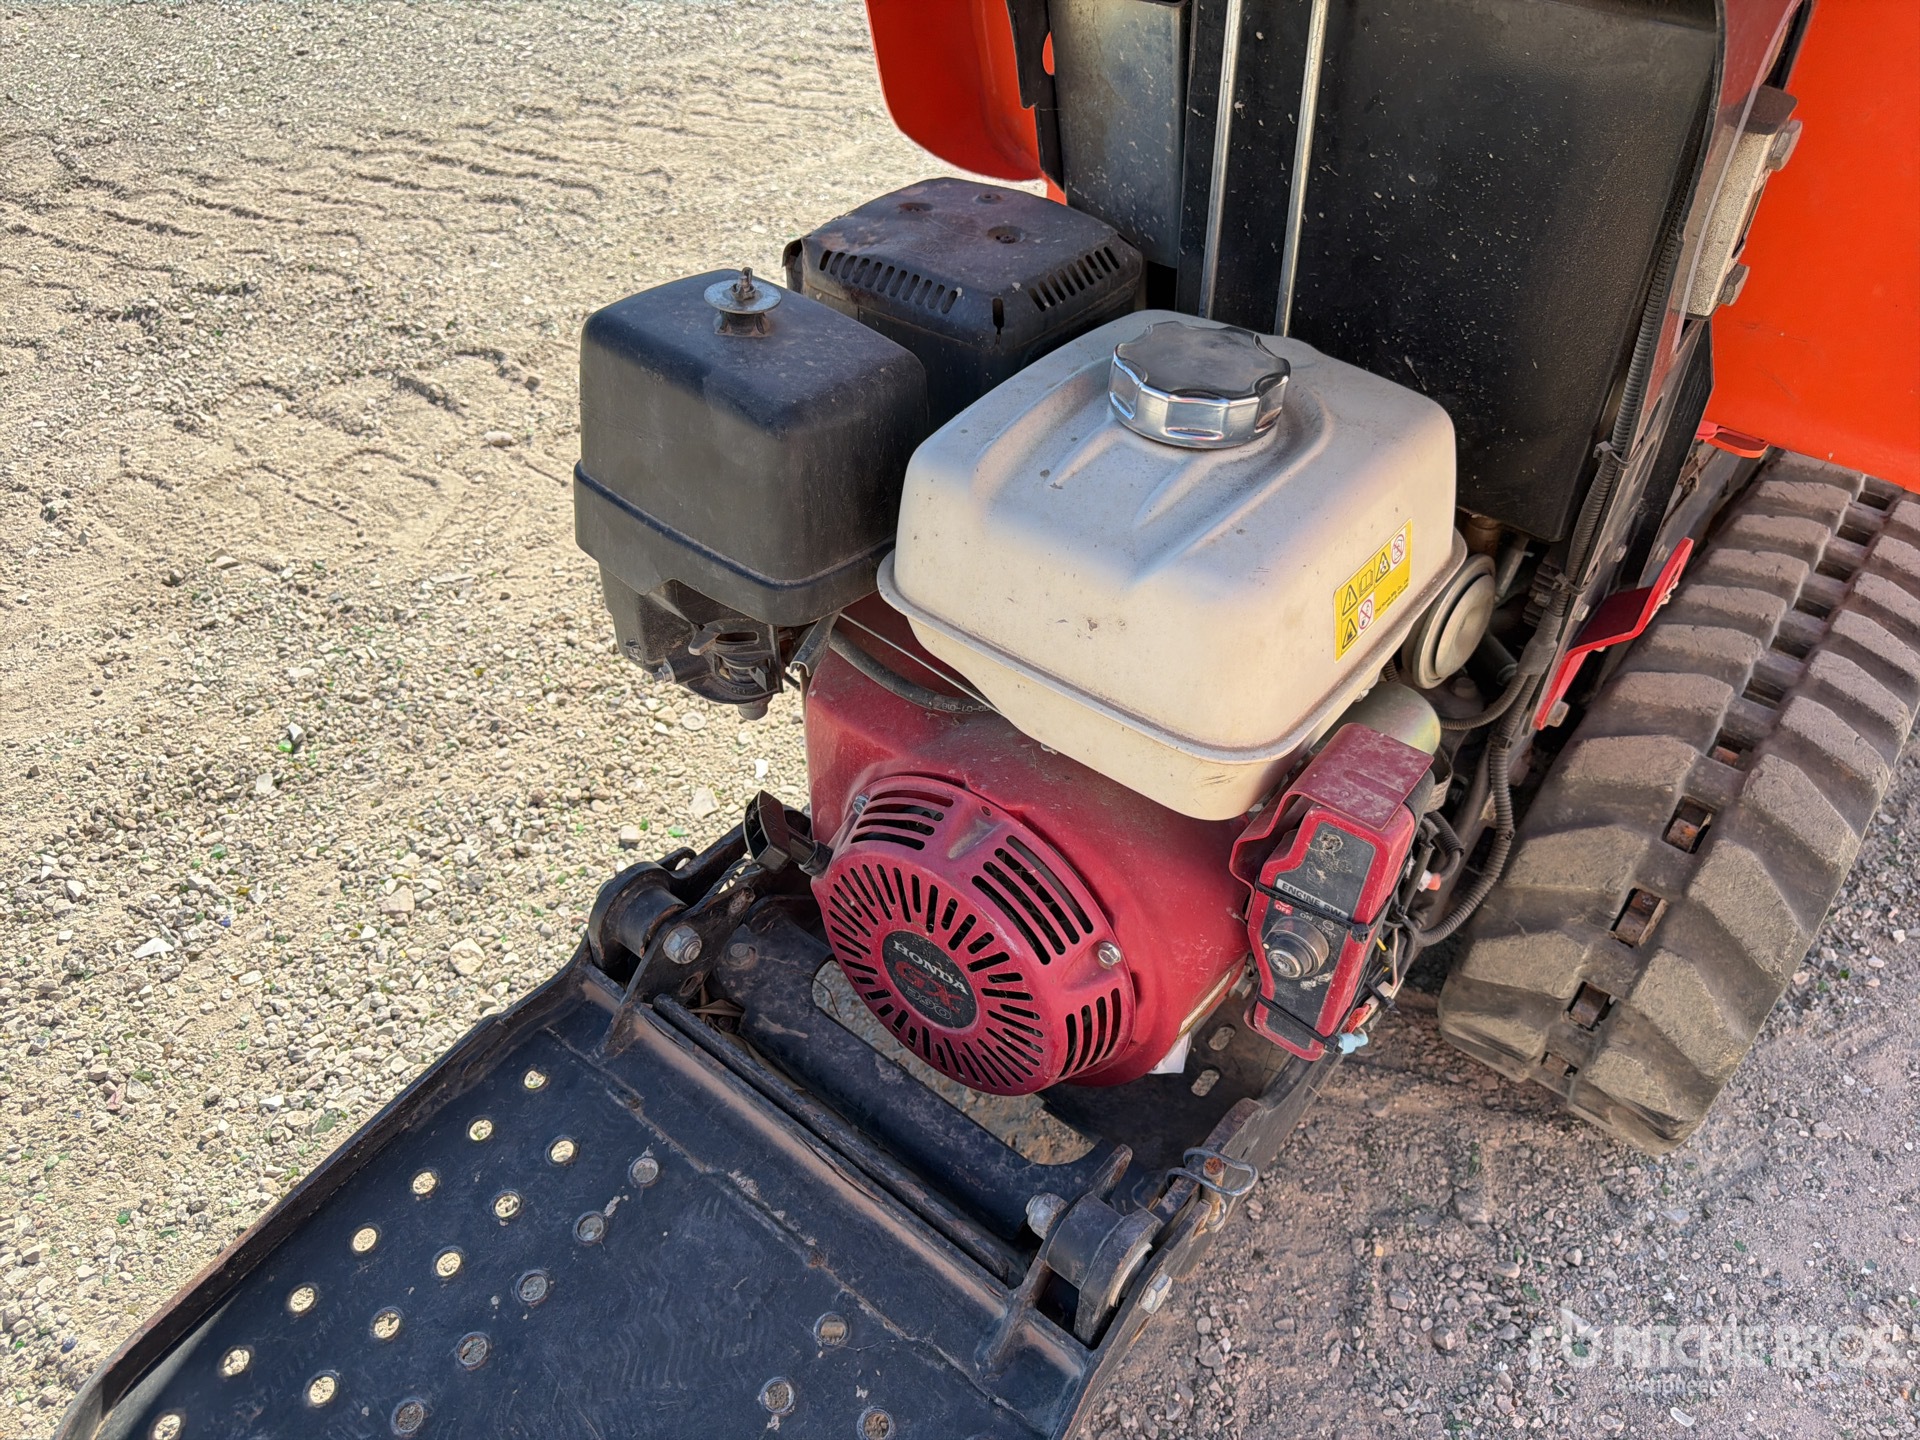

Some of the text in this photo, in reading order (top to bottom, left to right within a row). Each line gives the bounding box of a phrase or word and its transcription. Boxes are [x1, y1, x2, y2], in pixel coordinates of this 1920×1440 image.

[1282, 882, 1321, 907] ENGINE
[1275, 904, 1291, 916] OFF
[1300, 912, 1312, 921] ON
[893, 940, 969, 996] HONDA
[895, 961, 964, 1014] GX
